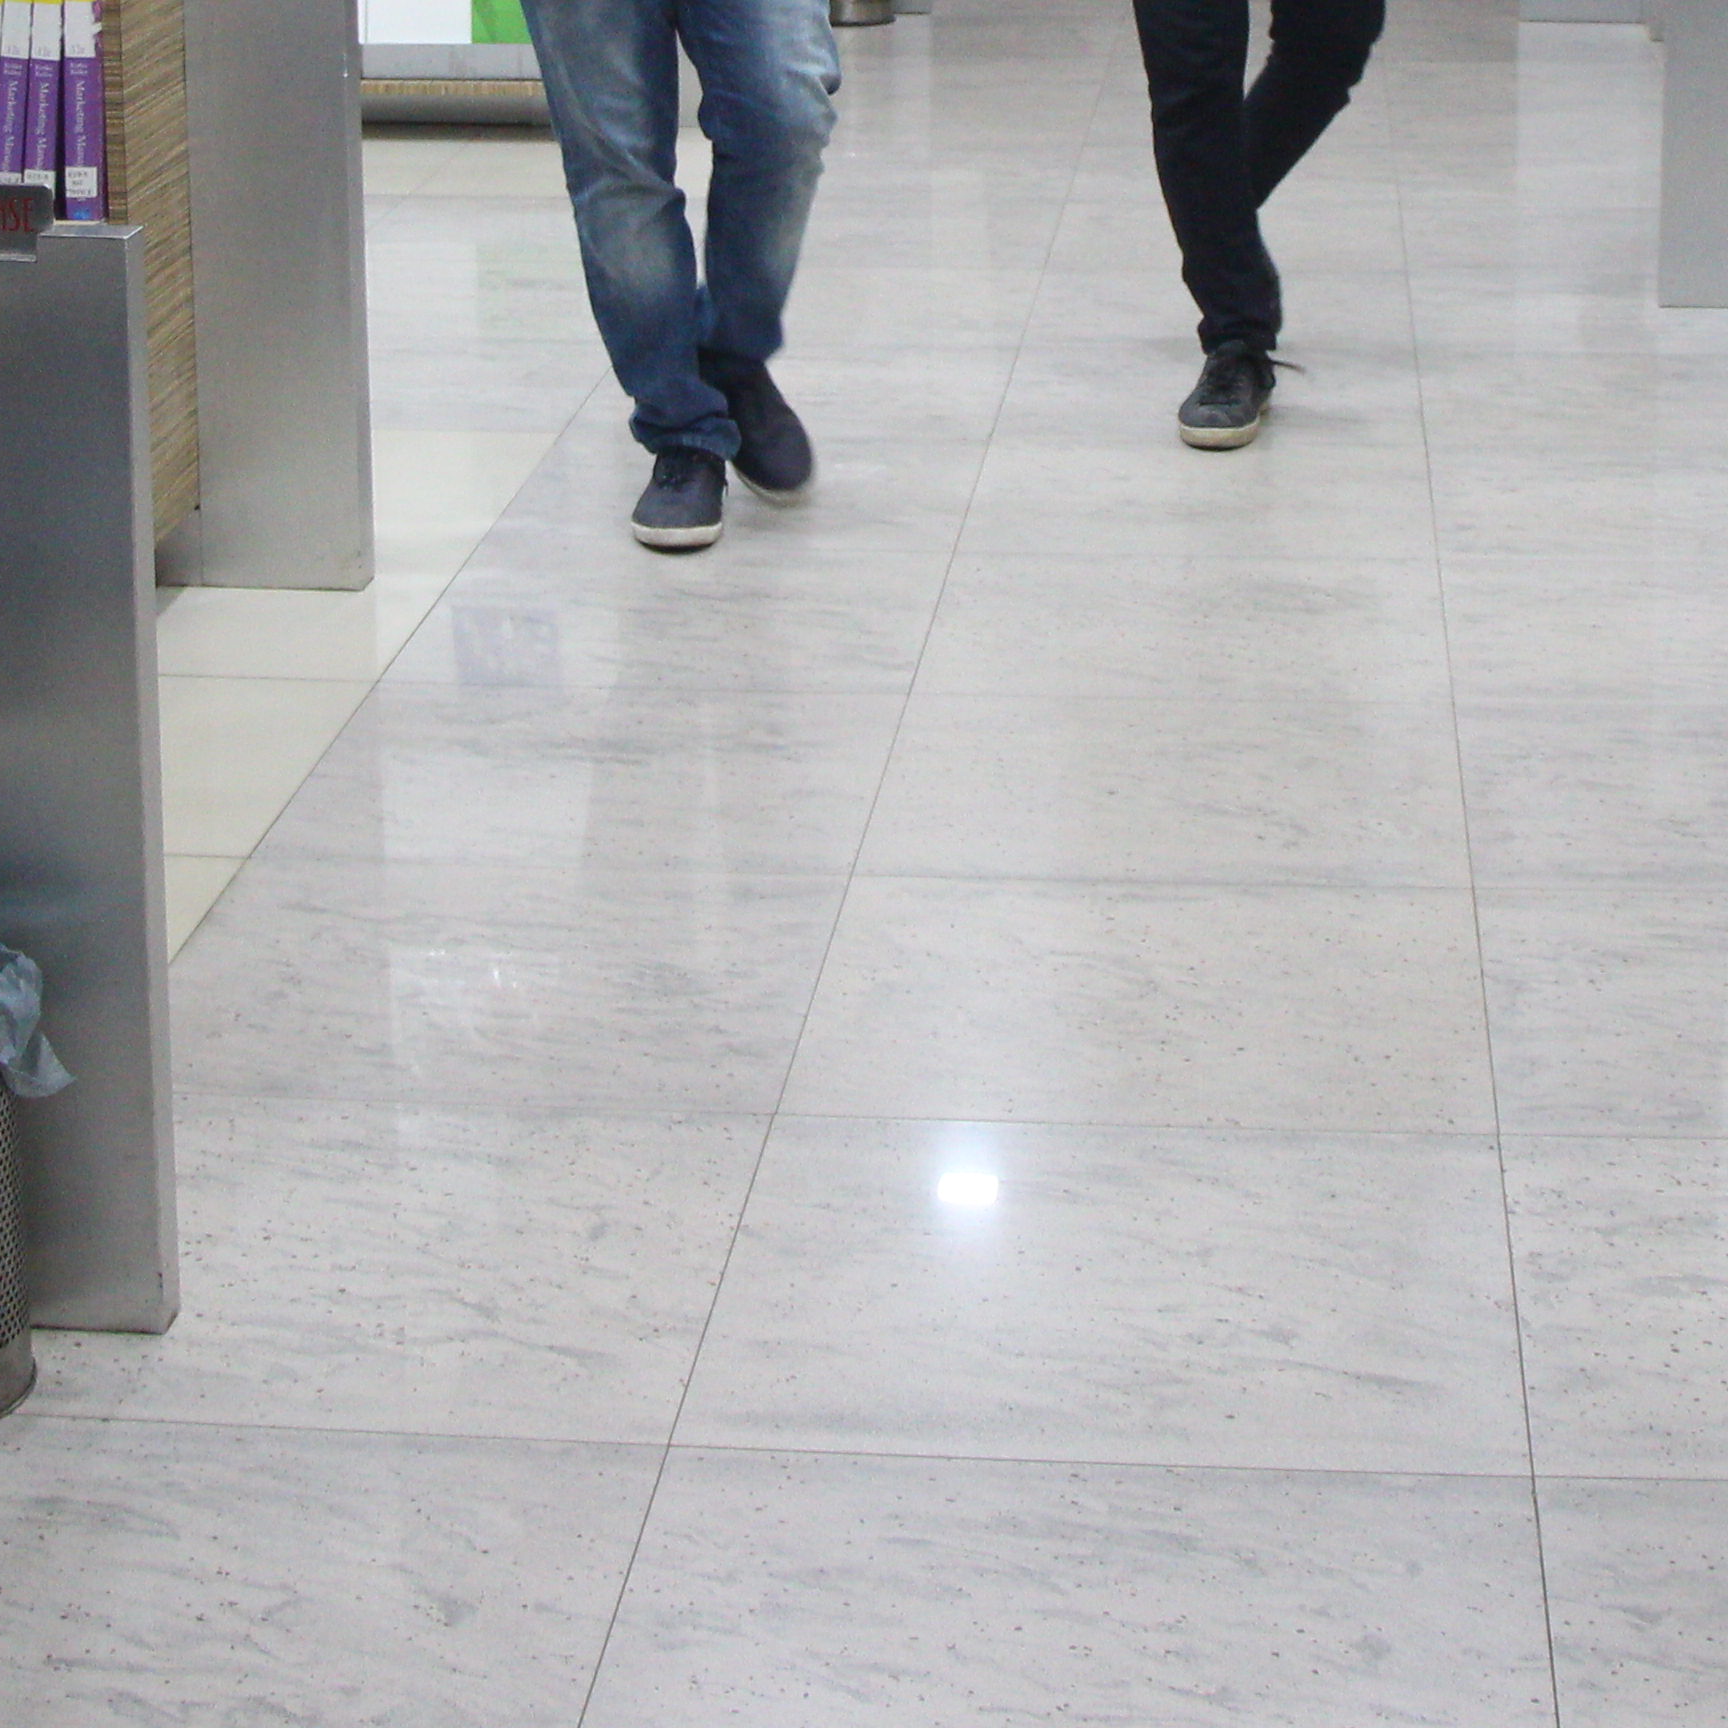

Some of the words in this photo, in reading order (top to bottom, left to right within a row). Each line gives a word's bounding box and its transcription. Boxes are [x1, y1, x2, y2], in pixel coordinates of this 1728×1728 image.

[5, 80, 18, 133] Marketing
[36, 82, 49, 134] Marketing
[73, 80, 86, 133] Marketing
